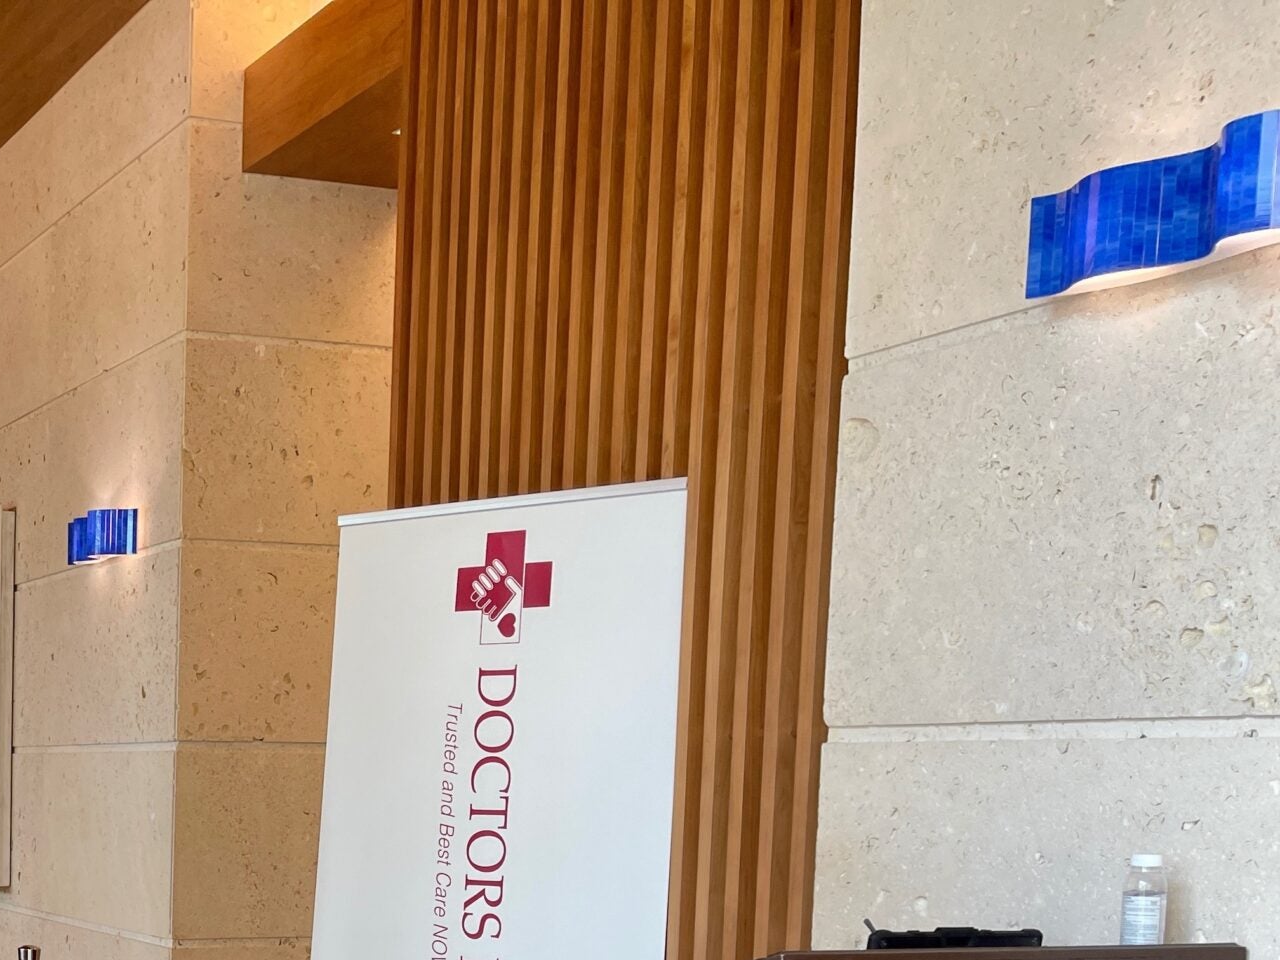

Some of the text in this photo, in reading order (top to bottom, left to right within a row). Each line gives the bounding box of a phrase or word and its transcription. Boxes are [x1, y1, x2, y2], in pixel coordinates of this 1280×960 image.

[443, 702, 463, 775] Trusted
[439, 777, 455, 817] and
[461, 664, 518, 940] DOCTORS
[436, 823, 455, 867] Best
[433, 872, 452, 917] Care
